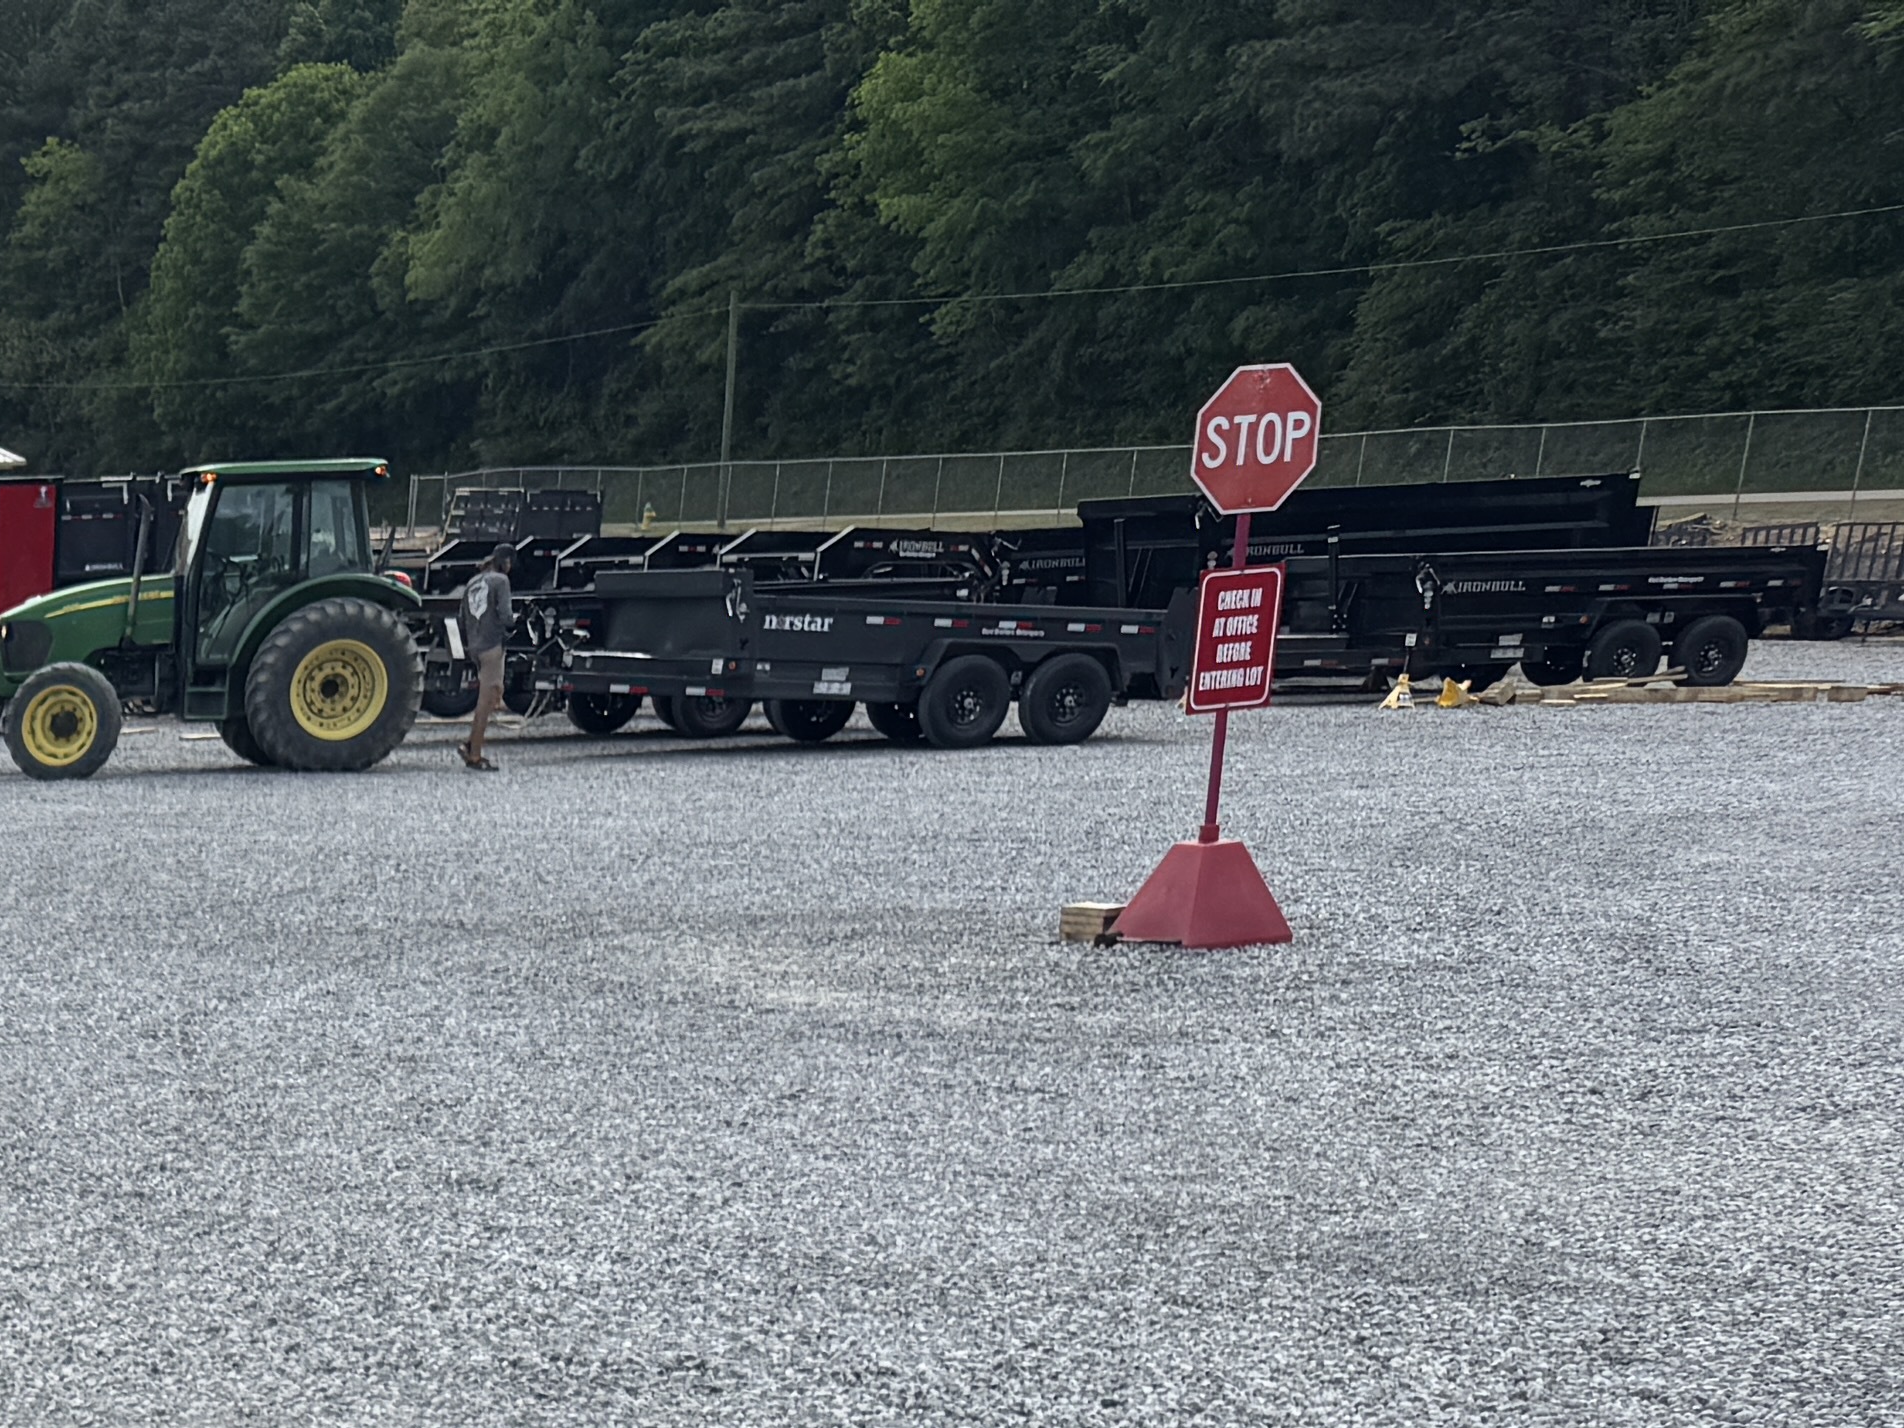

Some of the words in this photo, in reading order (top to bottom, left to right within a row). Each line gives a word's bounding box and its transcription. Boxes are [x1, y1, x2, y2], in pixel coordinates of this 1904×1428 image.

[1201, 410, 1311, 469] STOP
[1246, 544, 1304, 556] RONBULL
[1217, 589, 1250, 611] CHECK
[1250, 587, 1263, 608] IN
[1212, 616, 1226, 638] AT
[1226, 614, 1259, 636] OFFICE
[1215, 641, 1252, 663] BEFORE
[1198, 667, 1245, 691] ENTERING
[1245, 666, 1264, 687] LOT
